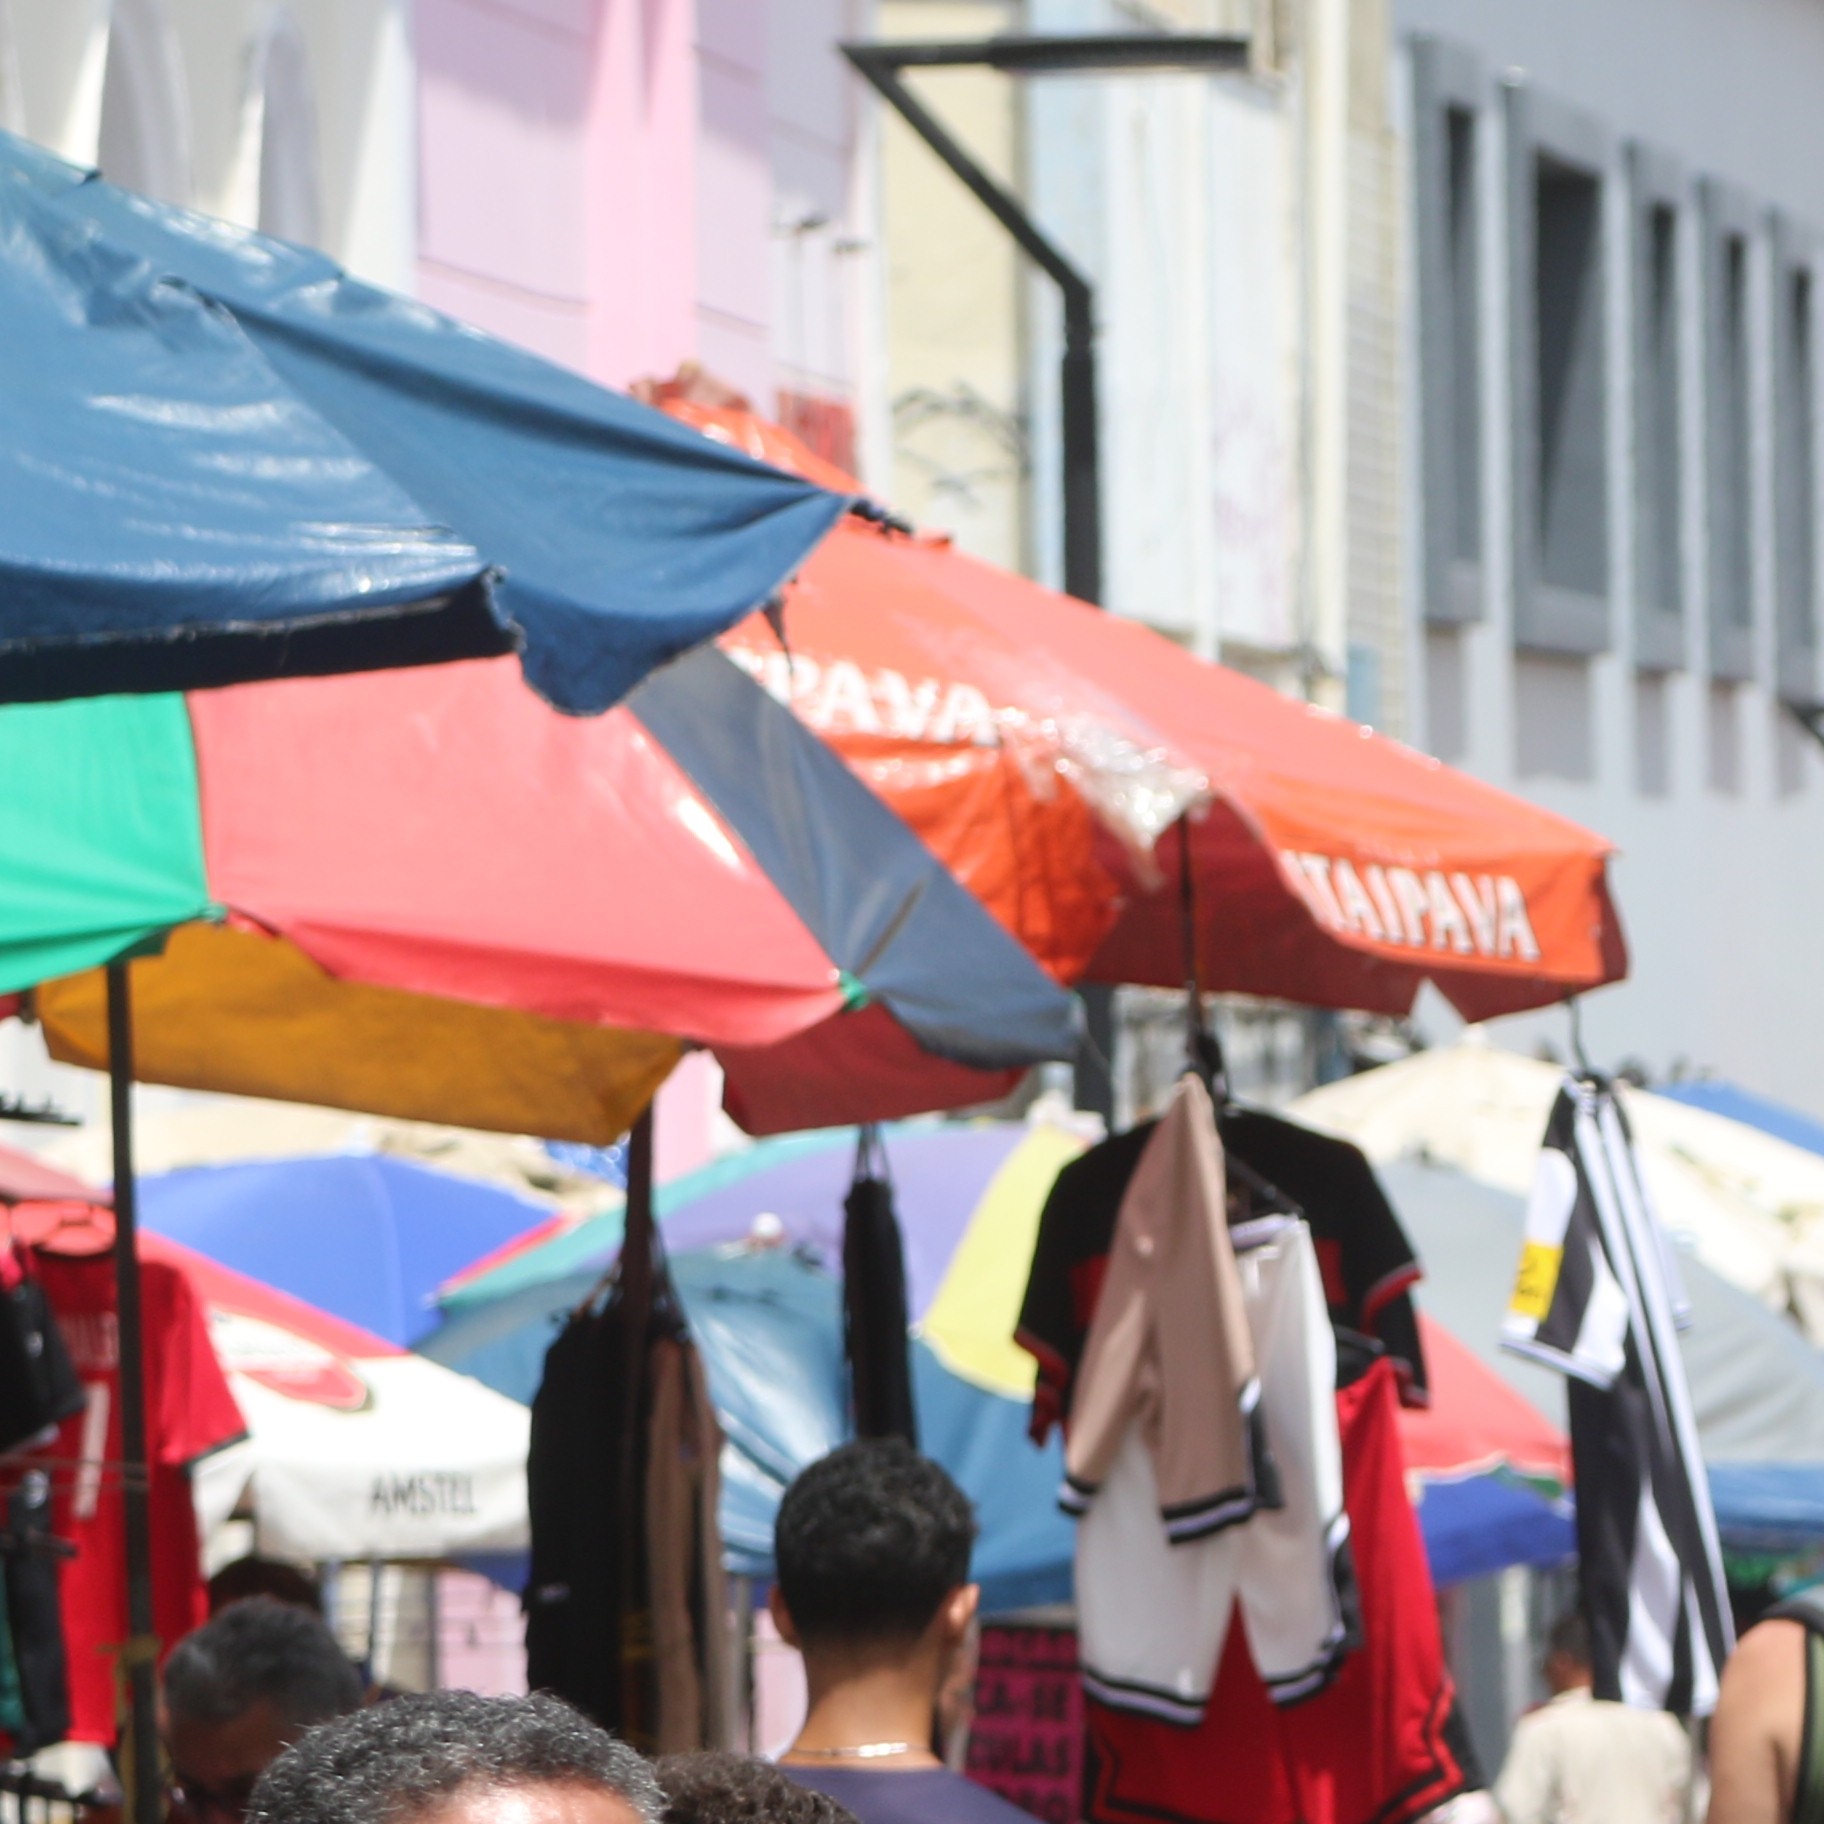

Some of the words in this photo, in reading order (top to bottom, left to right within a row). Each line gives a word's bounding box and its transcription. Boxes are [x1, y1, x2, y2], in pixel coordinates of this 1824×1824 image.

[734, 645, 1003, 748] PAVA
[1278, 848, 1543, 964] ITAIPAVA
[367, 1472, 478, 1518] AMSTEL
